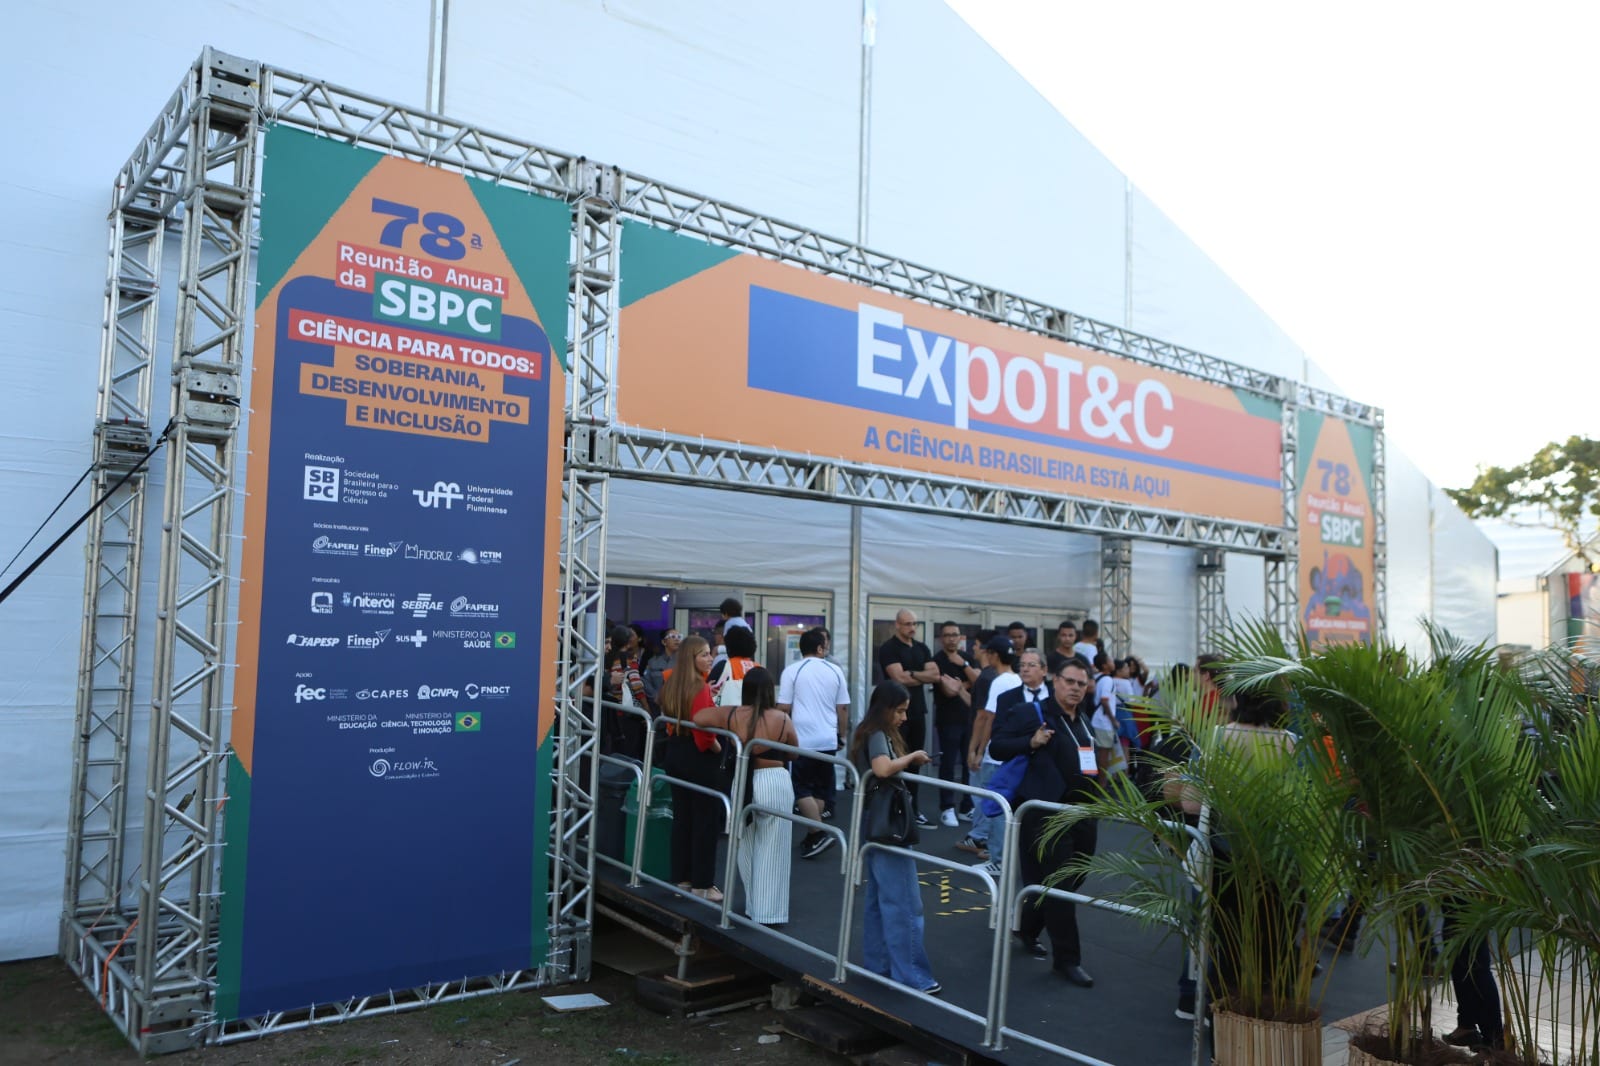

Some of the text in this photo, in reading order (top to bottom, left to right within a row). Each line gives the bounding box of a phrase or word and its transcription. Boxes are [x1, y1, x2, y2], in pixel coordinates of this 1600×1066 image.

[340, 245, 505, 295] Reunião Anual
[339, 269, 367, 289] da
[379, 279, 493, 333] SBPC
[298, 318, 535, 374] CIÊNCIA PARA TODOS:
[355, 354, 486, 391] SOBERANIA,
[857, 302, 1174, 451] ExpoT&C
[311, 373, 521, 418] DESENVOLVIMENTO
[356, 405, 482, 436] E INCLUSÃO
[304, 452, 345, 463] Realização
[863, 426, 1170, 499] A CIÊNCIA BRASILEIRA ESTÁ AQUI
[343, 469, 380, 479] Sociedade
[343, 478, 376, 488] Brasileira
[377, 482, 393, 490] para
[343, 487, 388, 498] Progresso da
[412, 481, 464, 509] uff
[467, 484, 513, 496] Universidade
[342, 496, 368, 505] Ciência
[466, 494, 494, 503] Federal
[466, 504, 508, 514] Fluminense
[1322, 514, 1362, 546] SBPC
[364, 543, 394, 557] Finep
[419, 549, 453, 561] FIOCRUZ
[480, 550, 502, 559] ICTIM
[401, 600, 444, 610] SEBRAE
[465, 603, 499, 611] FAPERJ
[432, 630, 491, 639] MINISTÉRIO DA
[302, 637, 340, 647] FAPESP
[347, 634, 380, 648] Finep
[463, 639, 491, 648] SAÚDE
[294, 684, 327, 703] fec
[371, 689, 409, 698] CAPES
[430, 688, 459, 699] CNPq
[480, 686, 510, 694] FNDCT
[327, 714, 366, 722] MINISTÉRIO
[405, 712, 442, 720] MINISTÉRIO
[339, 721, 377, 730] EDUCAÇÃO
[380, 719, 452, 728] CIÊNCIA, TECNOLOGIA
[418, 726, 452, 734] INOVAÇÃO
